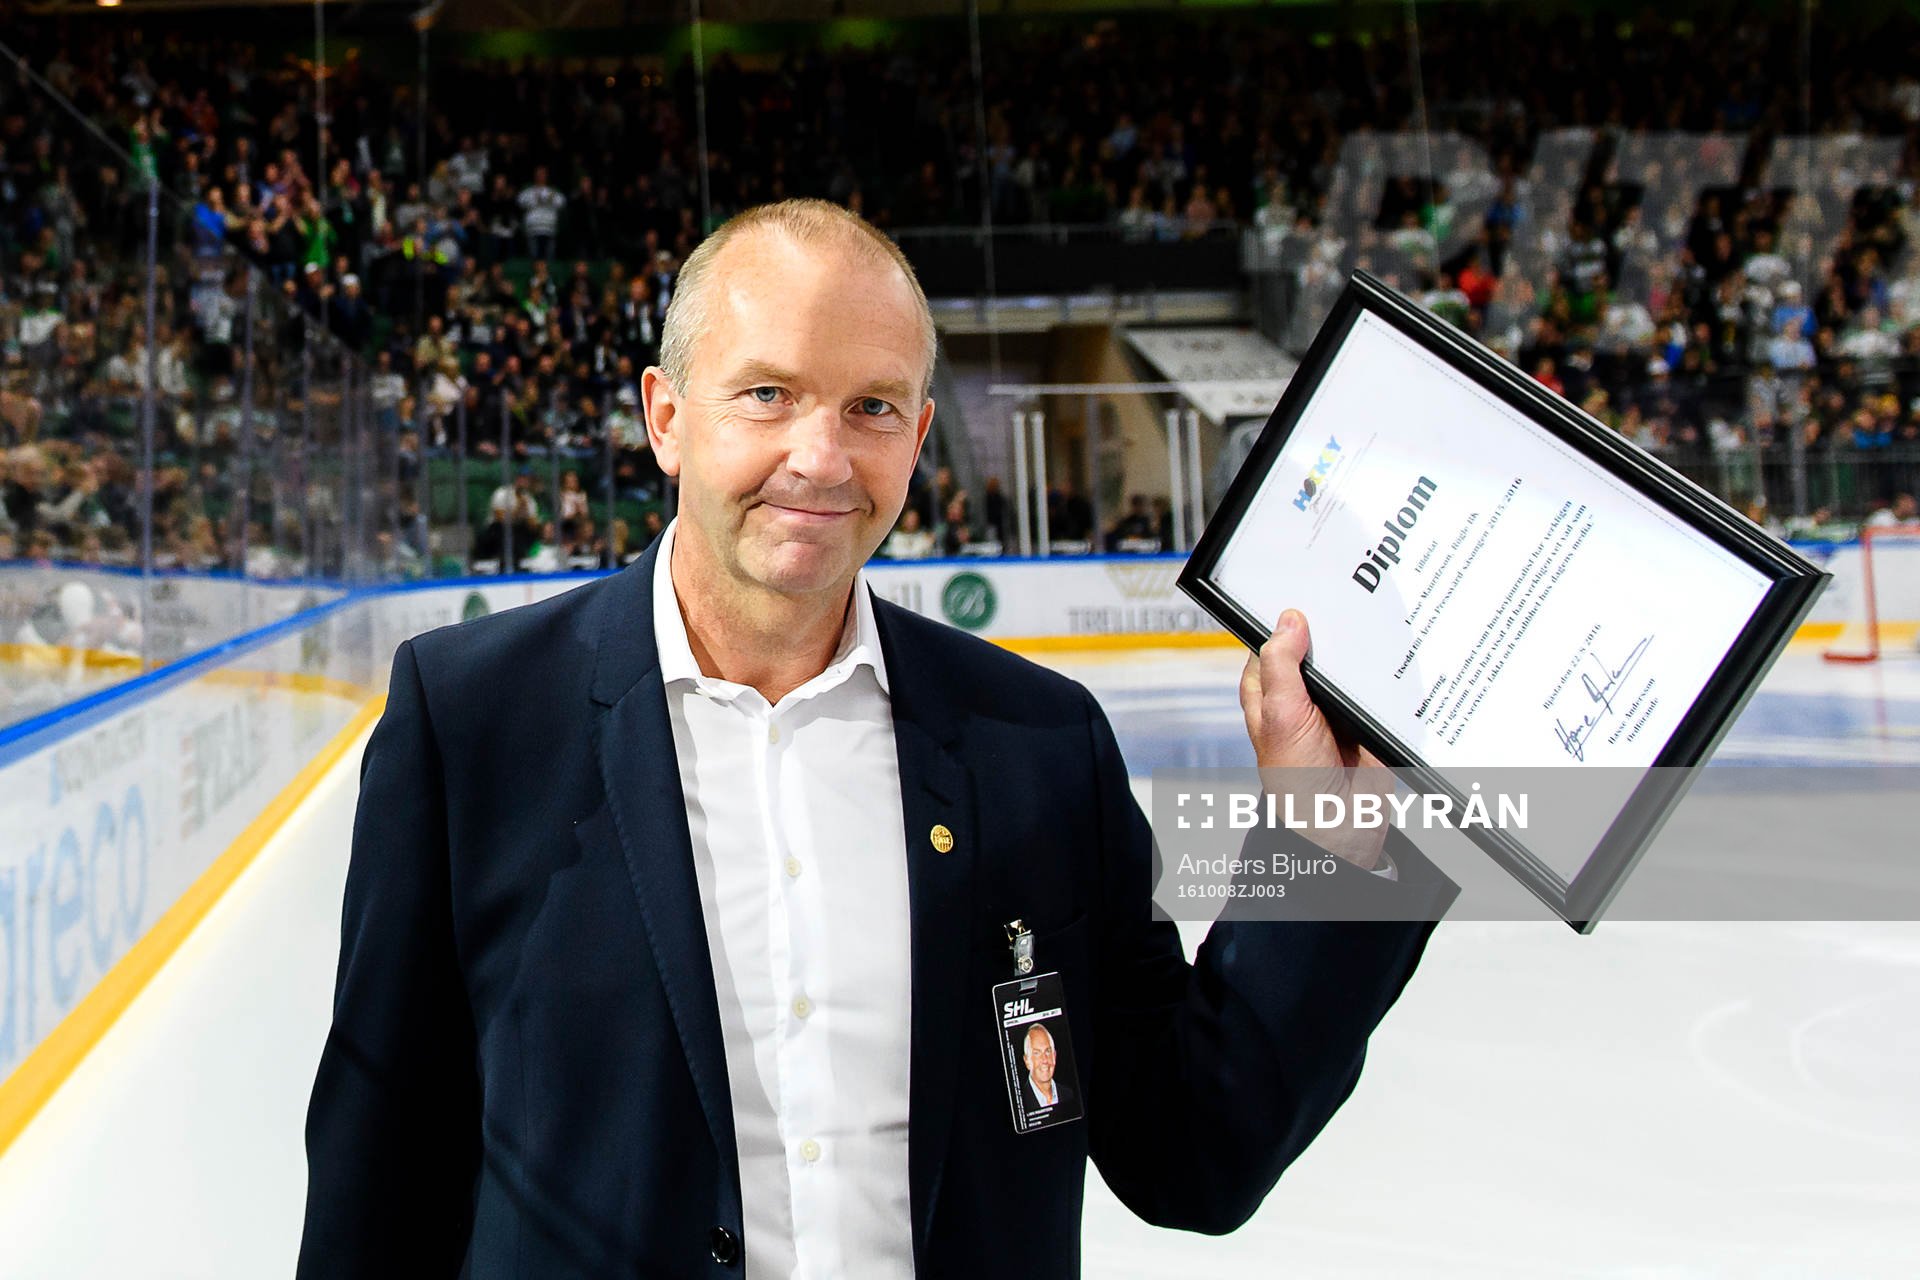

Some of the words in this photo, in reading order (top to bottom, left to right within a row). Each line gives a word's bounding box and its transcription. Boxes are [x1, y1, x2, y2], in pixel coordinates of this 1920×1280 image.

[1351, 474, 1438, 594] Diplom
[1414, 540, 1438, 572] Tilldelat
[1475, 630, 1490, 648] som
[1531, 542, 1545, 558] har
[1543, 499, 1573, 541] verkligen
[1467, 668, 1482, 685] han
[1478, 651, 1492, 668] har
[1523, 556, 1553, 597] verkligen
[1571, 503, 1587, 523] som
[1404, 600, 1422, 625] Lasse
[1393, 649, 1415, 679] Utsedd
[1559, 668, 1572, 684] den
[1607, 720, 1626, 744] Hasse
[1004, 998, 1034, 1019] SHL
